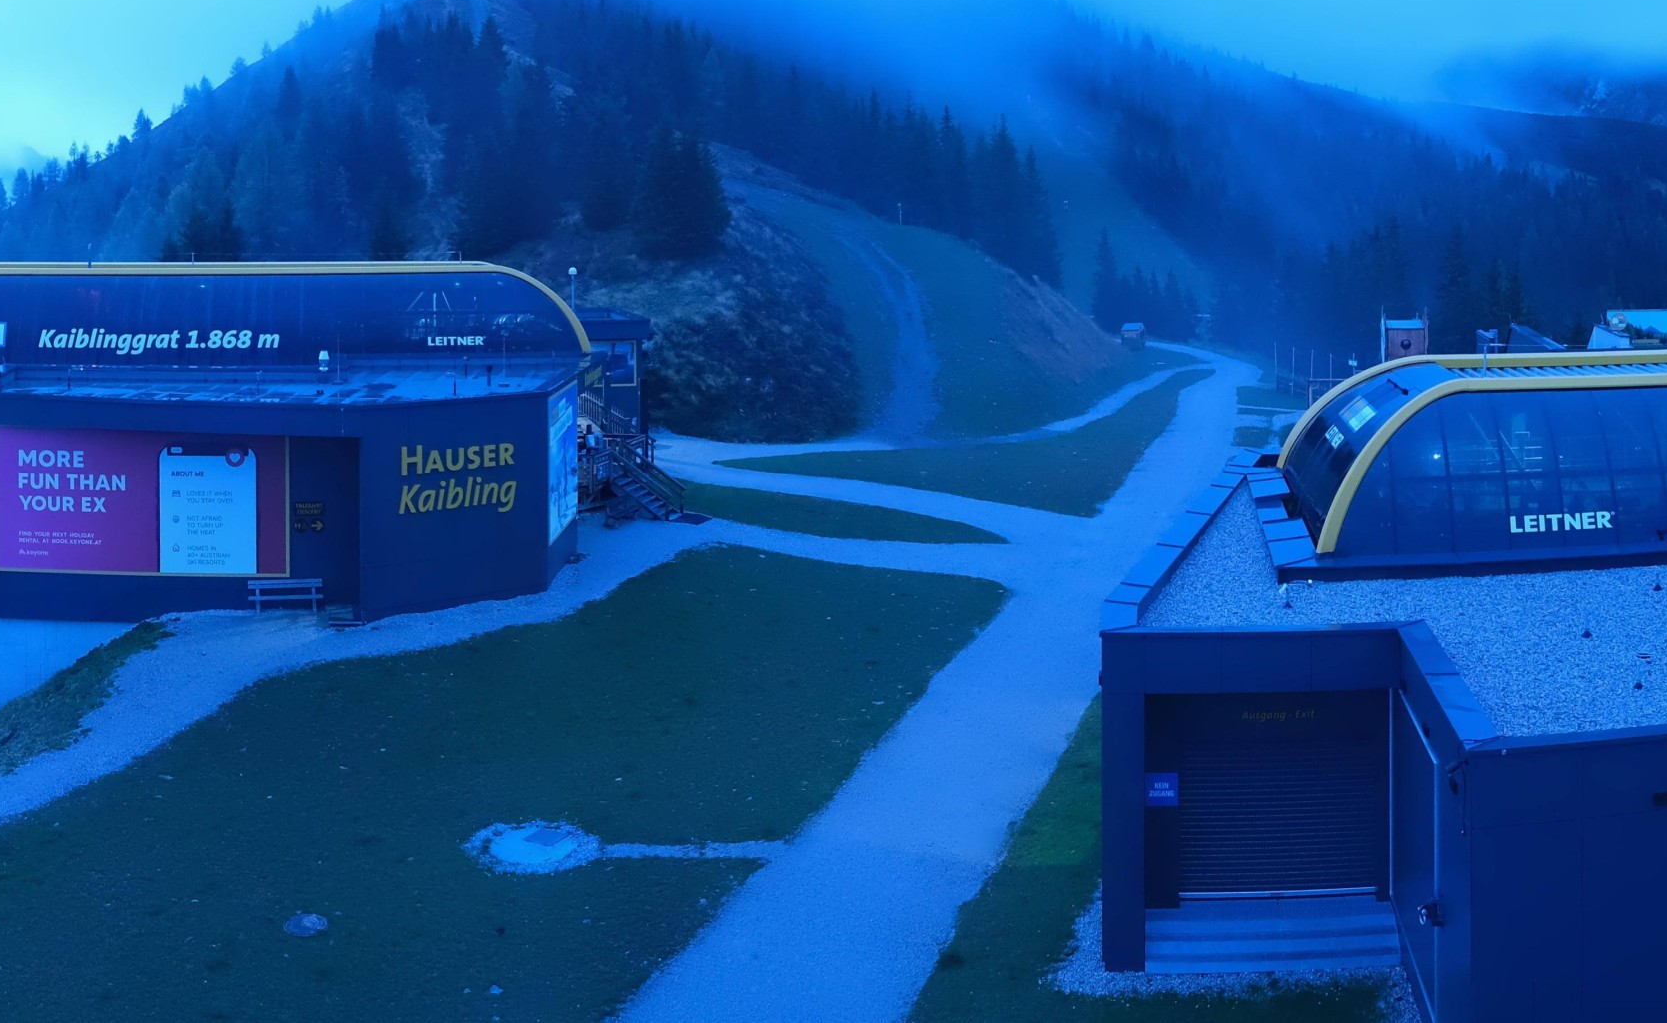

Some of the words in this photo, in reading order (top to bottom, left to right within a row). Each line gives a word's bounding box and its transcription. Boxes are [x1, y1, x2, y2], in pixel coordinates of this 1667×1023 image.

[38, 328, 179, 355] Kaiblinggrat
[185, 329, 251, 349] 1.868
[257, 333, 280, 349] m
[427, 336, 484, 346] LEITNER
[18, 449, 84, 468] MORE
[401, 443, 515, 476] HAUSER
[18, 472, 59, 490] FUN
[66, 474, 126, 491] THAN
[19, 494, 75, 512] YOUR
[81, 496, 107, 513] EX
[399, 477, 517, 515] Kaibling
[1509, 511, 1613, 533] LEITNER
[1241, 710, 1286, 722] Ausgang
[1295, 709, 1315, 719] Exit
